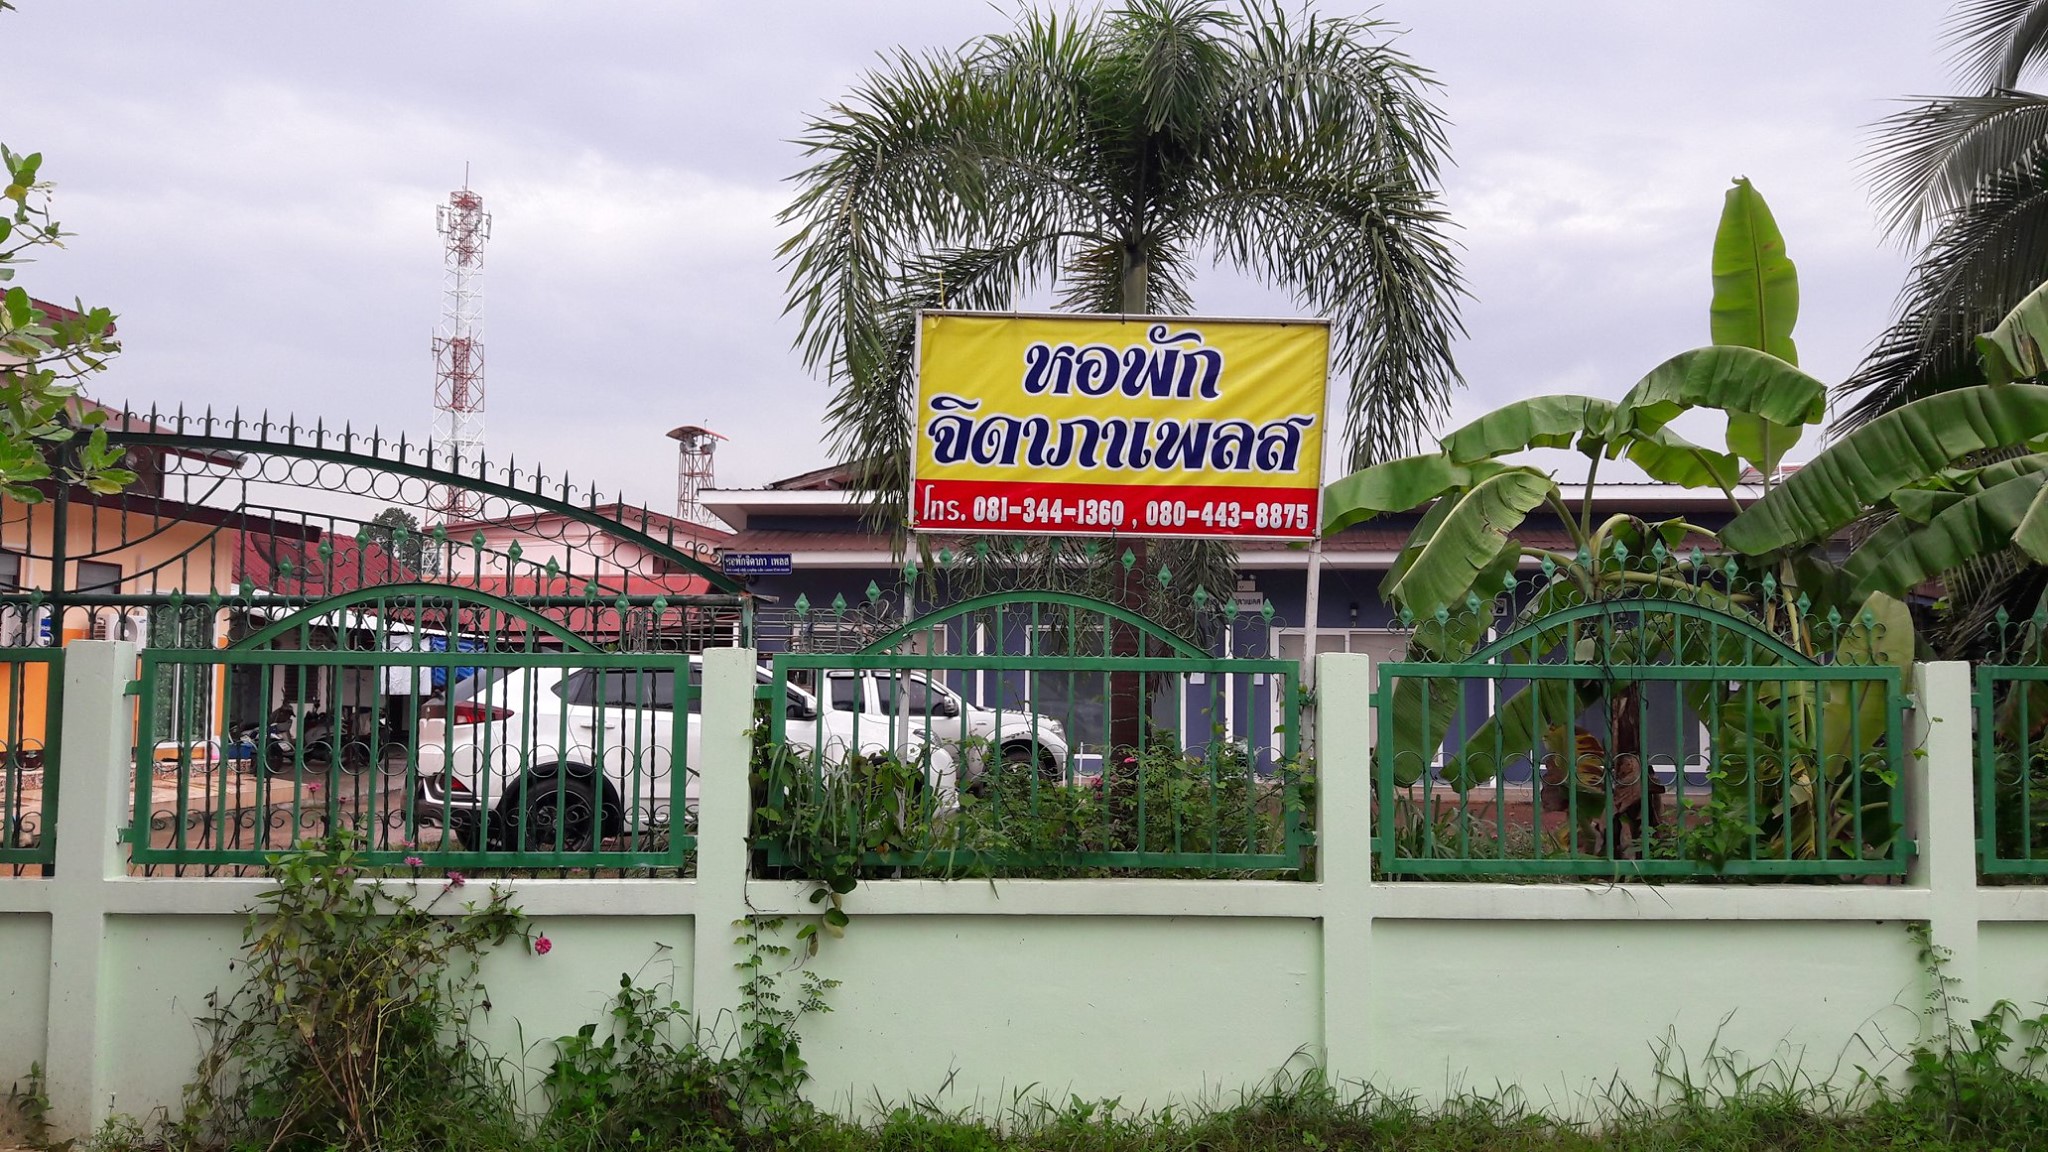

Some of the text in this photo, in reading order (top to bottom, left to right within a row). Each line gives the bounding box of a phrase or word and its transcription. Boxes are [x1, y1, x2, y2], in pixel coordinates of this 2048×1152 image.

[1023, 325, 1223, 399] หอพัก
[928, 394, 1316, 472] จิดาภาเพลส
[922, 484, 966, 522] โทร.
[973, 496, 1125, 526] 081-344-1360
[1145, 499, 1309, 530] 080-443-8875
